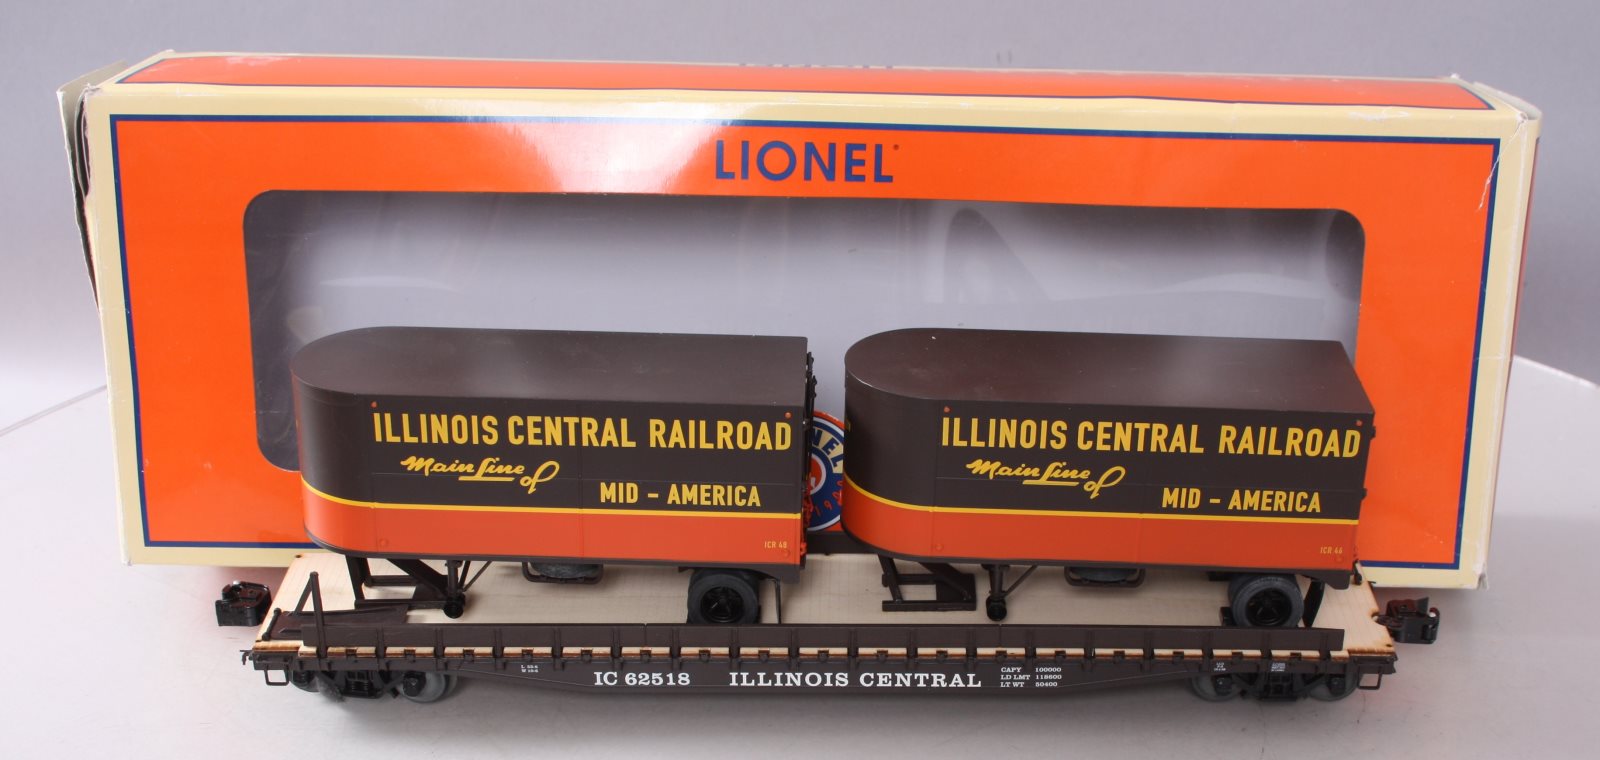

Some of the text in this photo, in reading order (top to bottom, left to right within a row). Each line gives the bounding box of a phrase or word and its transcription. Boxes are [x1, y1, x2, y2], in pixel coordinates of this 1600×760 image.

[715, 140, 894, 183] LIONEL
[373, 412, 792, 451] ILLINOIS CENTRAL RAILROAD
[941, 416, 1361, 458] ILLINOIS CENTRAL RAILROAD
[519, 460, 560, 494] of
[1083, 465, 1126, 499] of
[600, 481, 639, 504] MID
[666, 483, 761, 507] AMERICA
[1161, 487, 1201, 509] MID
[1227, 489, 1321, 513] AMERICA
[764, 541, 777, 549] ICR
[593, 671, 691, 686] IC 62518
[729, 672, 982, 688] ILLINOIS CENTRAL
